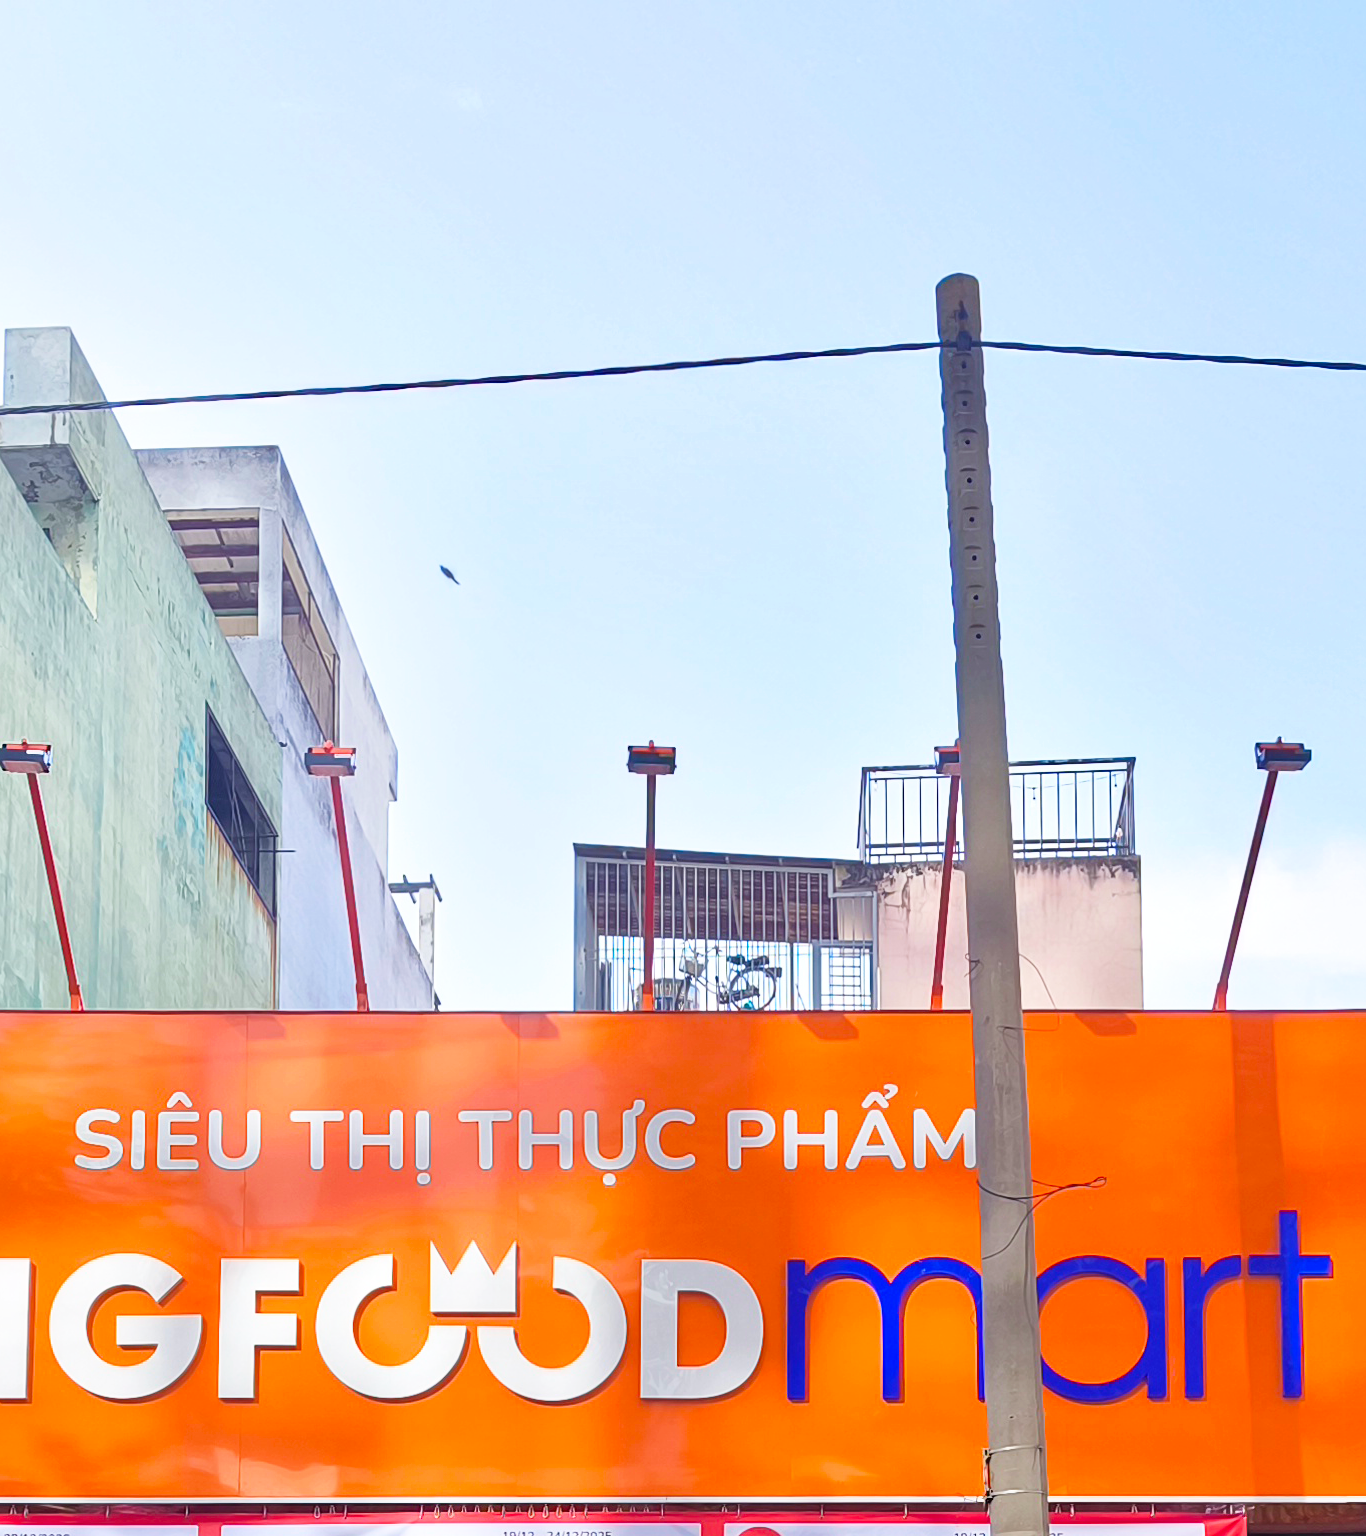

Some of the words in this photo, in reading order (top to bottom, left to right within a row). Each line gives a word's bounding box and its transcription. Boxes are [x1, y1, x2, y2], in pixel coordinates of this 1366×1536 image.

[73, 1091, 261, 1171] SIÊU
[291, 1108, 432, 1186] THỊ
[458, 1099, 696, 1186] THỰC
[727, 1084, 976, 1171] PHẨM
